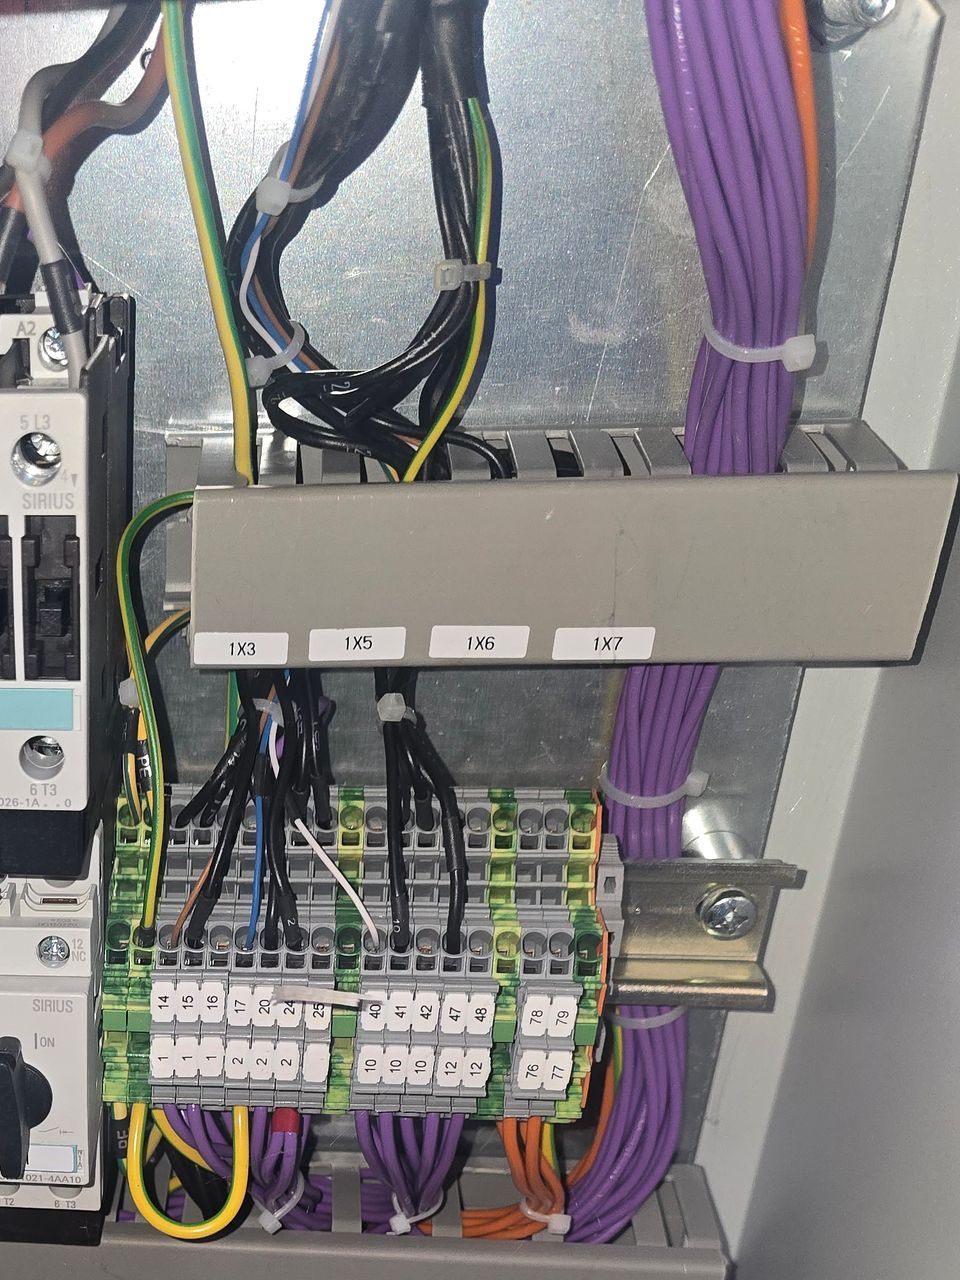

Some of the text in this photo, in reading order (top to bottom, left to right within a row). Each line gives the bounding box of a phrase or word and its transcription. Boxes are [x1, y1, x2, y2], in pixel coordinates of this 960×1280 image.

[16, 321, 36, 336] A2
[20, 414, 51, 430] 5 L3
[22, 492, 75, 509] SIRIUS
[228, 641, 256, 656] 1X3
[344, 636, 373, 650] 1X5
[467, 635, 495, 650] 1X6
[593, 637, 623, 651] 1X7
[138, 757, 152, 778] PE
[29, 784, 57, 796] 6 T3
[71, 938, 84, 950] 12
[71, 951, 86, 962] NC
[32, 999, 73, 1013] SIRIUS
[158, 995, 170, 1009] 14
[182, 995, 194, 1009] 15
[207, 995, 218, 1009] 16
[234, 999, 246, 1014] 17
[258, 999, 271, 1014] 20
[283, 1000, 295, 1015] 24
[312, 1002, 325, 1018] 25
[369, 1003, 381, 1019] 40
[395, 1005, 407, 1019] 41
[420, 1005, 433, 1020] 42
[449, 1007, 461, 1022] 47
[474, 1007, 487, 1022] 48
[529, 1009, 544, 1025] 78
[555, 1010, 569, 1025] 79
[40, 1037, 55, 1048] ON
[365, 1059, 377, 1073] 10
[390, 1059, 402, 1073] 10
[415, 1060, 427, 1074] 10
[445, 1061, 458, 1076] 12
[470, 1061, 483, 1076] 12
[525, 1064, 540, 1079] 76
[551, 1065, 565, 1080] 77
[3, 1197, 15, 1206] T2
